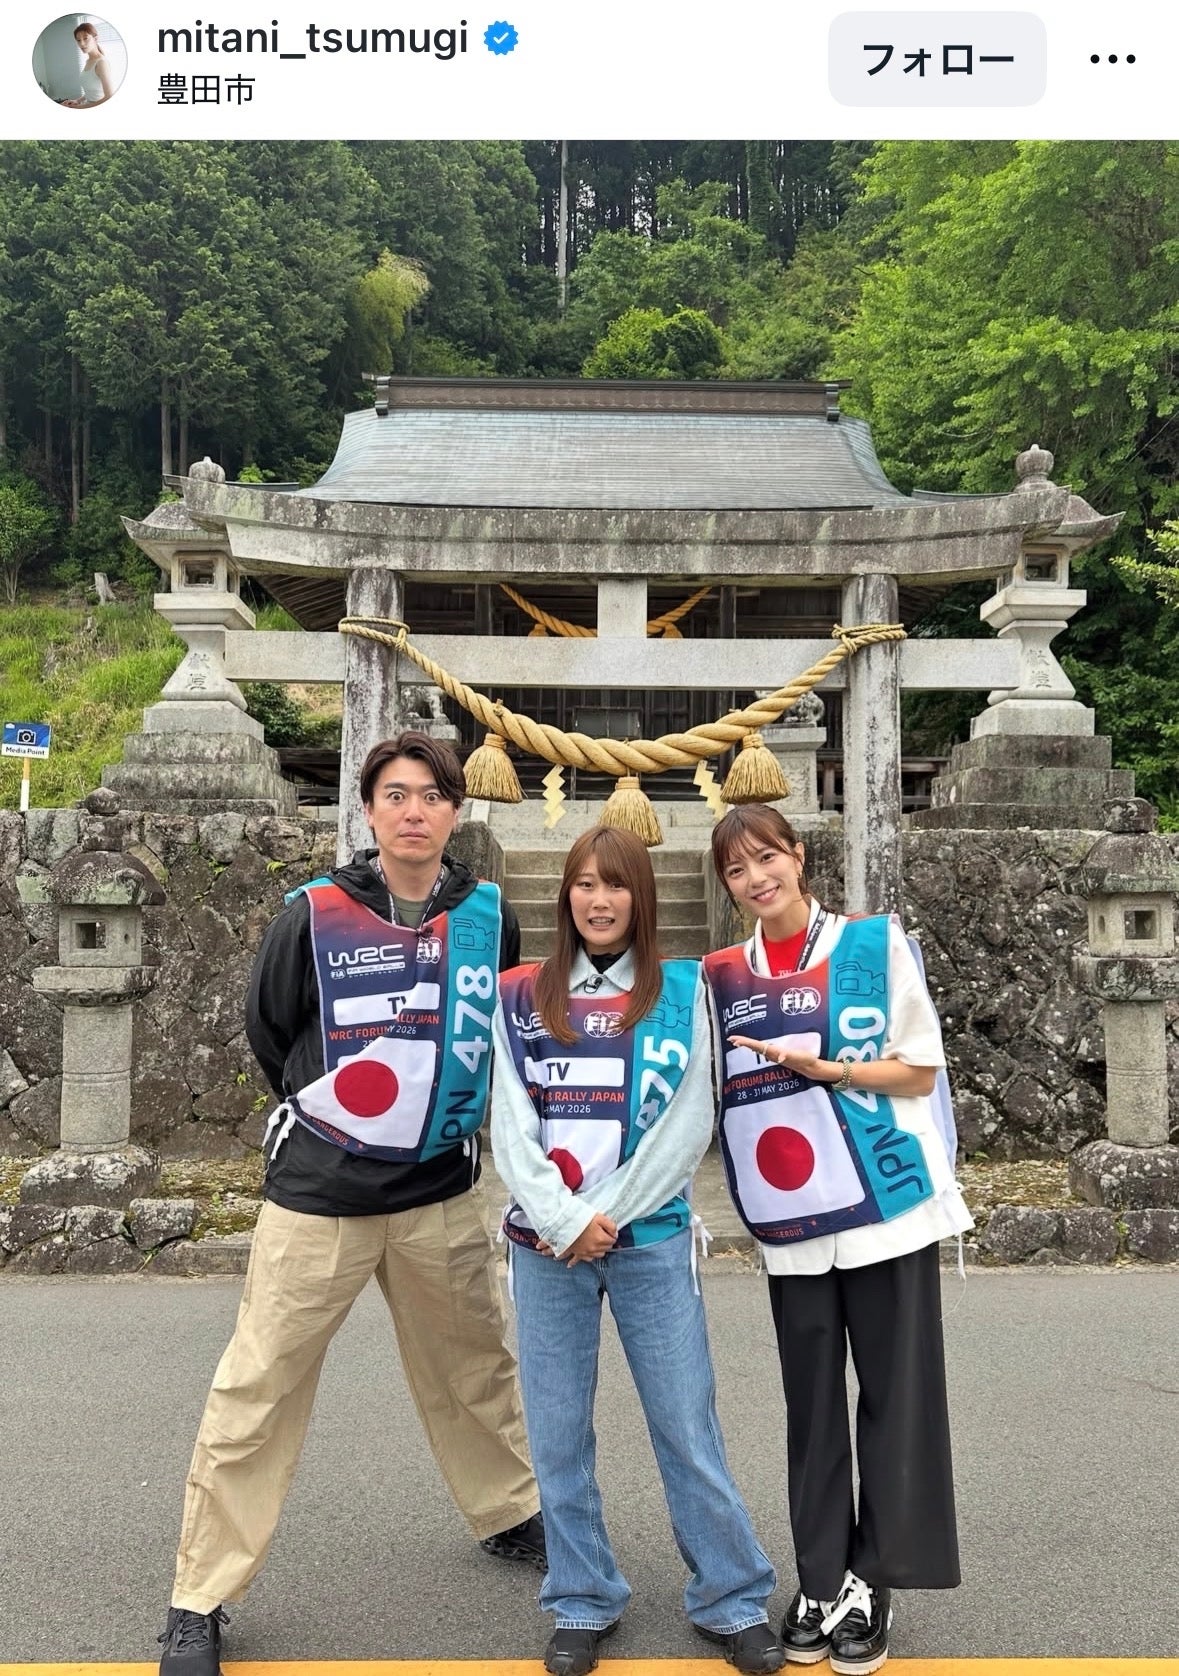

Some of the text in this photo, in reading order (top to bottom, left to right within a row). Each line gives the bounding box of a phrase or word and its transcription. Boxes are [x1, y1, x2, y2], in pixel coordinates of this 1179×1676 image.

[6, 746, 26, 754] Media
[328, 944, 404, 966] WRC
[722, 993, 767, 1023] WRC
[782, 991, 817, 1010] FIA
[452, 964, 494, 1074] 478
[329, 1029, 352, 1040] WRC
[396, 1026, 417, 1035] 2026
[546, 1062, 570, 1082] TV
[554, 1092, 588, 1102] RALLY
[589, 1092, 625, 1103] JAPAN
[736, 1090, 748, 1100] 28
[761, 1084, 776, 1096] MAY
[778, 1078, 800, 1092] 2026
[567, 1104, 591, 1113] 2026
[865, 1124, 924, 1194] JPN
